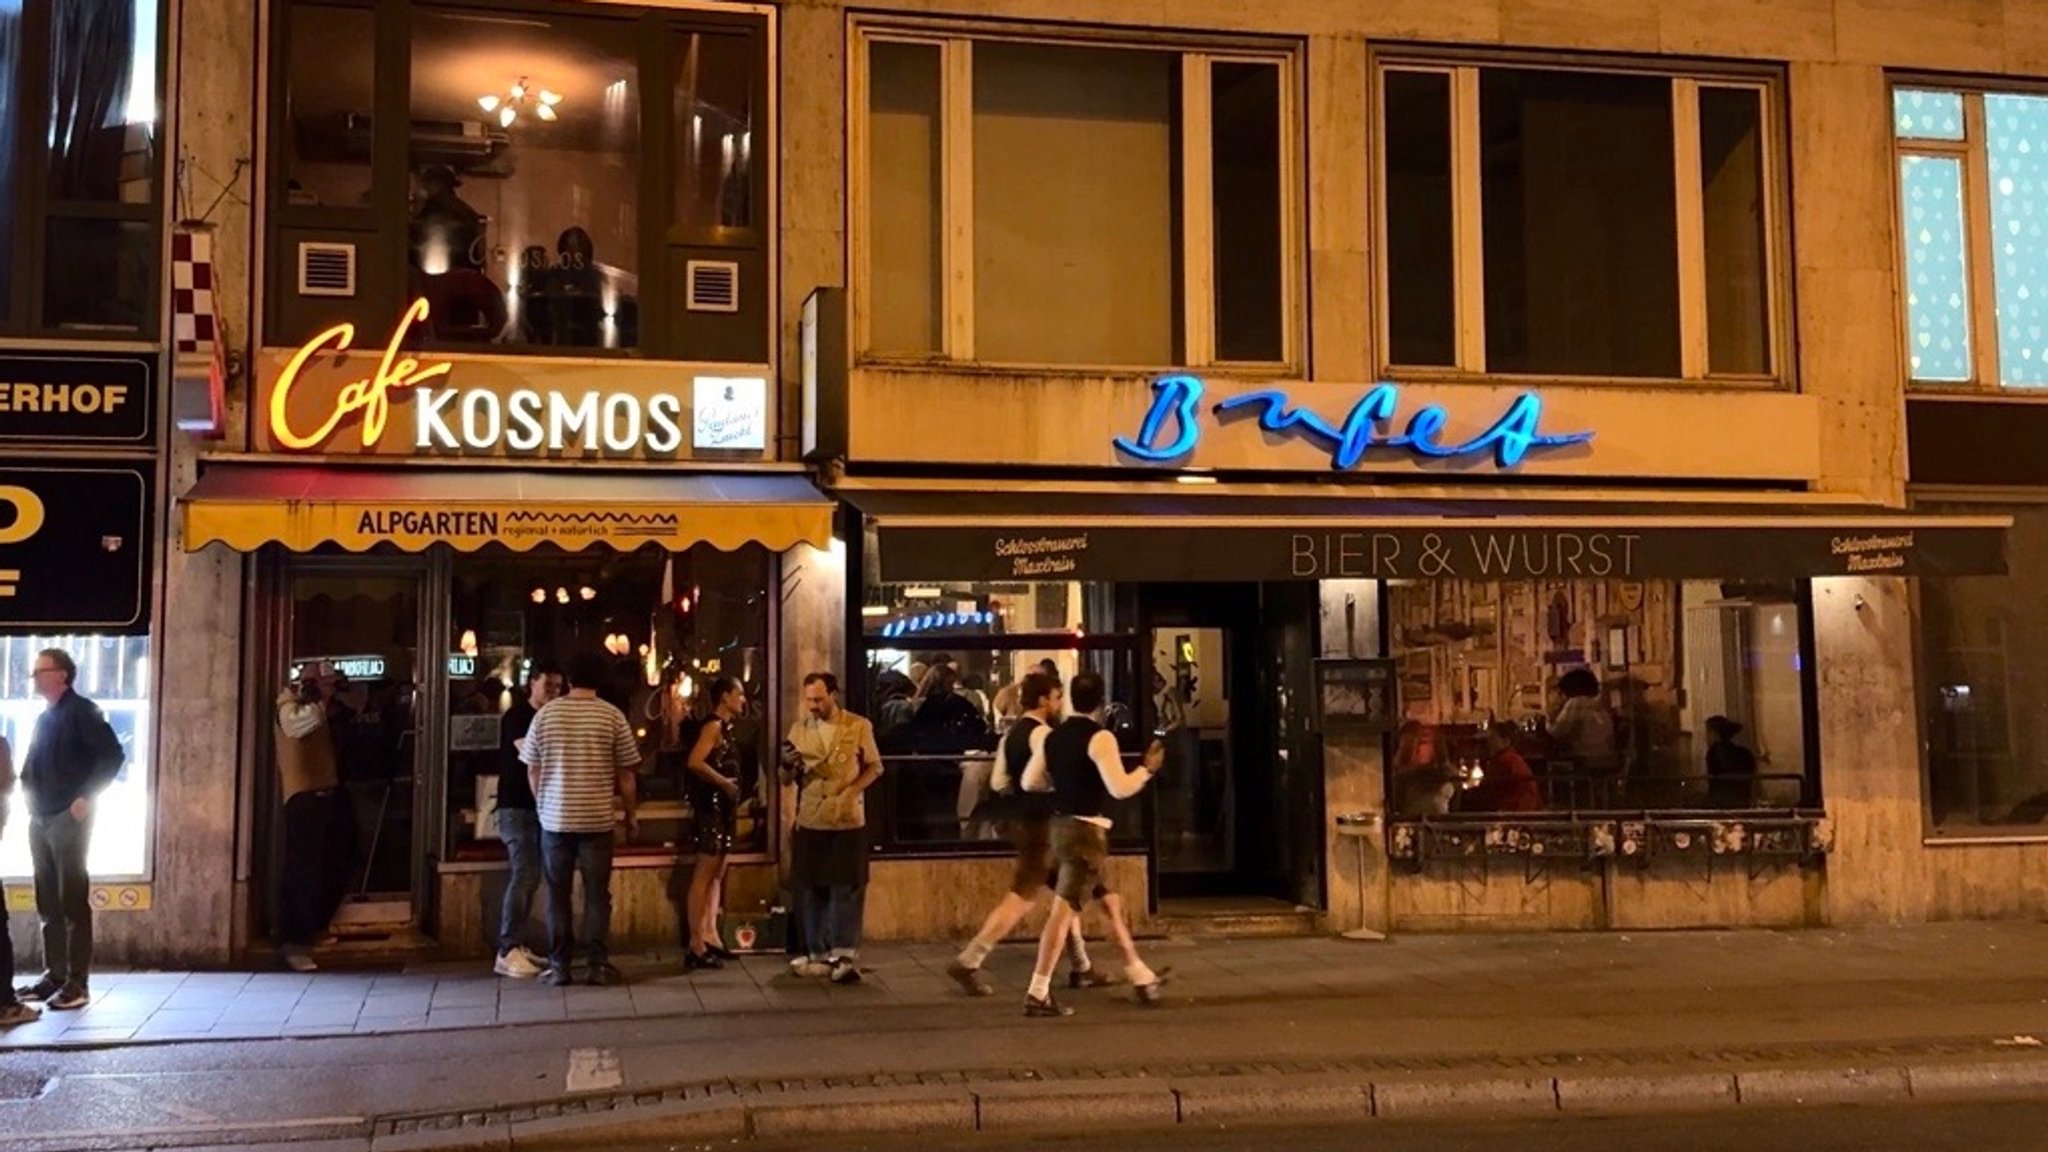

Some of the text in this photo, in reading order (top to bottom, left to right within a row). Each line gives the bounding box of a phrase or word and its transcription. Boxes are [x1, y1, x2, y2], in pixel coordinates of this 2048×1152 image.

[270, 298, 682, 452] Cafe KOSMOS
[357, 510, 498, 536] ALPGARTEN
[1291, 534, 1640, 576] BIER & WURST
